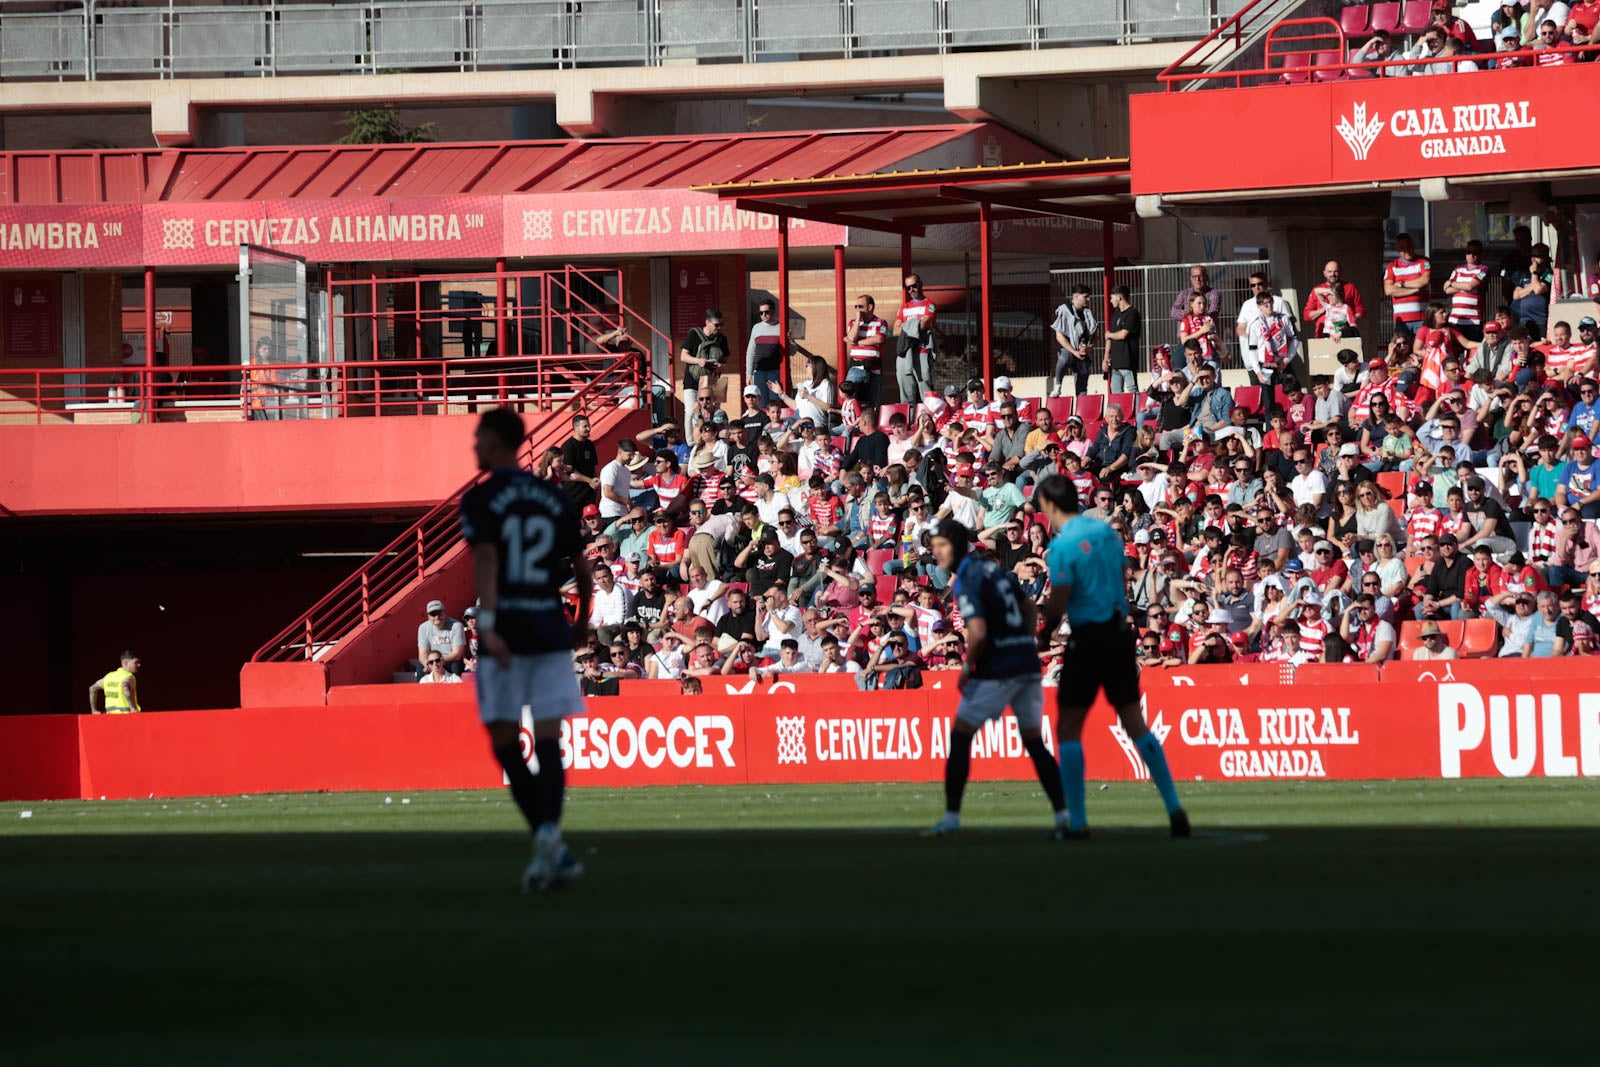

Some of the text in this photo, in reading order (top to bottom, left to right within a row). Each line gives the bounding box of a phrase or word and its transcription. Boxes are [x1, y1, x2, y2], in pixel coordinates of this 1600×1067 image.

[1391, 101, 1537, 138] CAJA RURAL
[1420, 135, 1507, 159] GRANADA
[103, 222, 123, 237] SIN
[205, 213, 484, 247] CERVEZAS ALHAMBRA SIN
[562, 204, 806, 238] CERVEZAS ALHAMB
[500, 513, 556, 585] 12
[559, 715, 737, 769] BESOCCER
[814, 714, 1055, 761] CERVEZAS ALAMBA
[1179, 706, 1359, 748] CAJA RURAL
[1220, 749, 1326, 779] GRANADA
